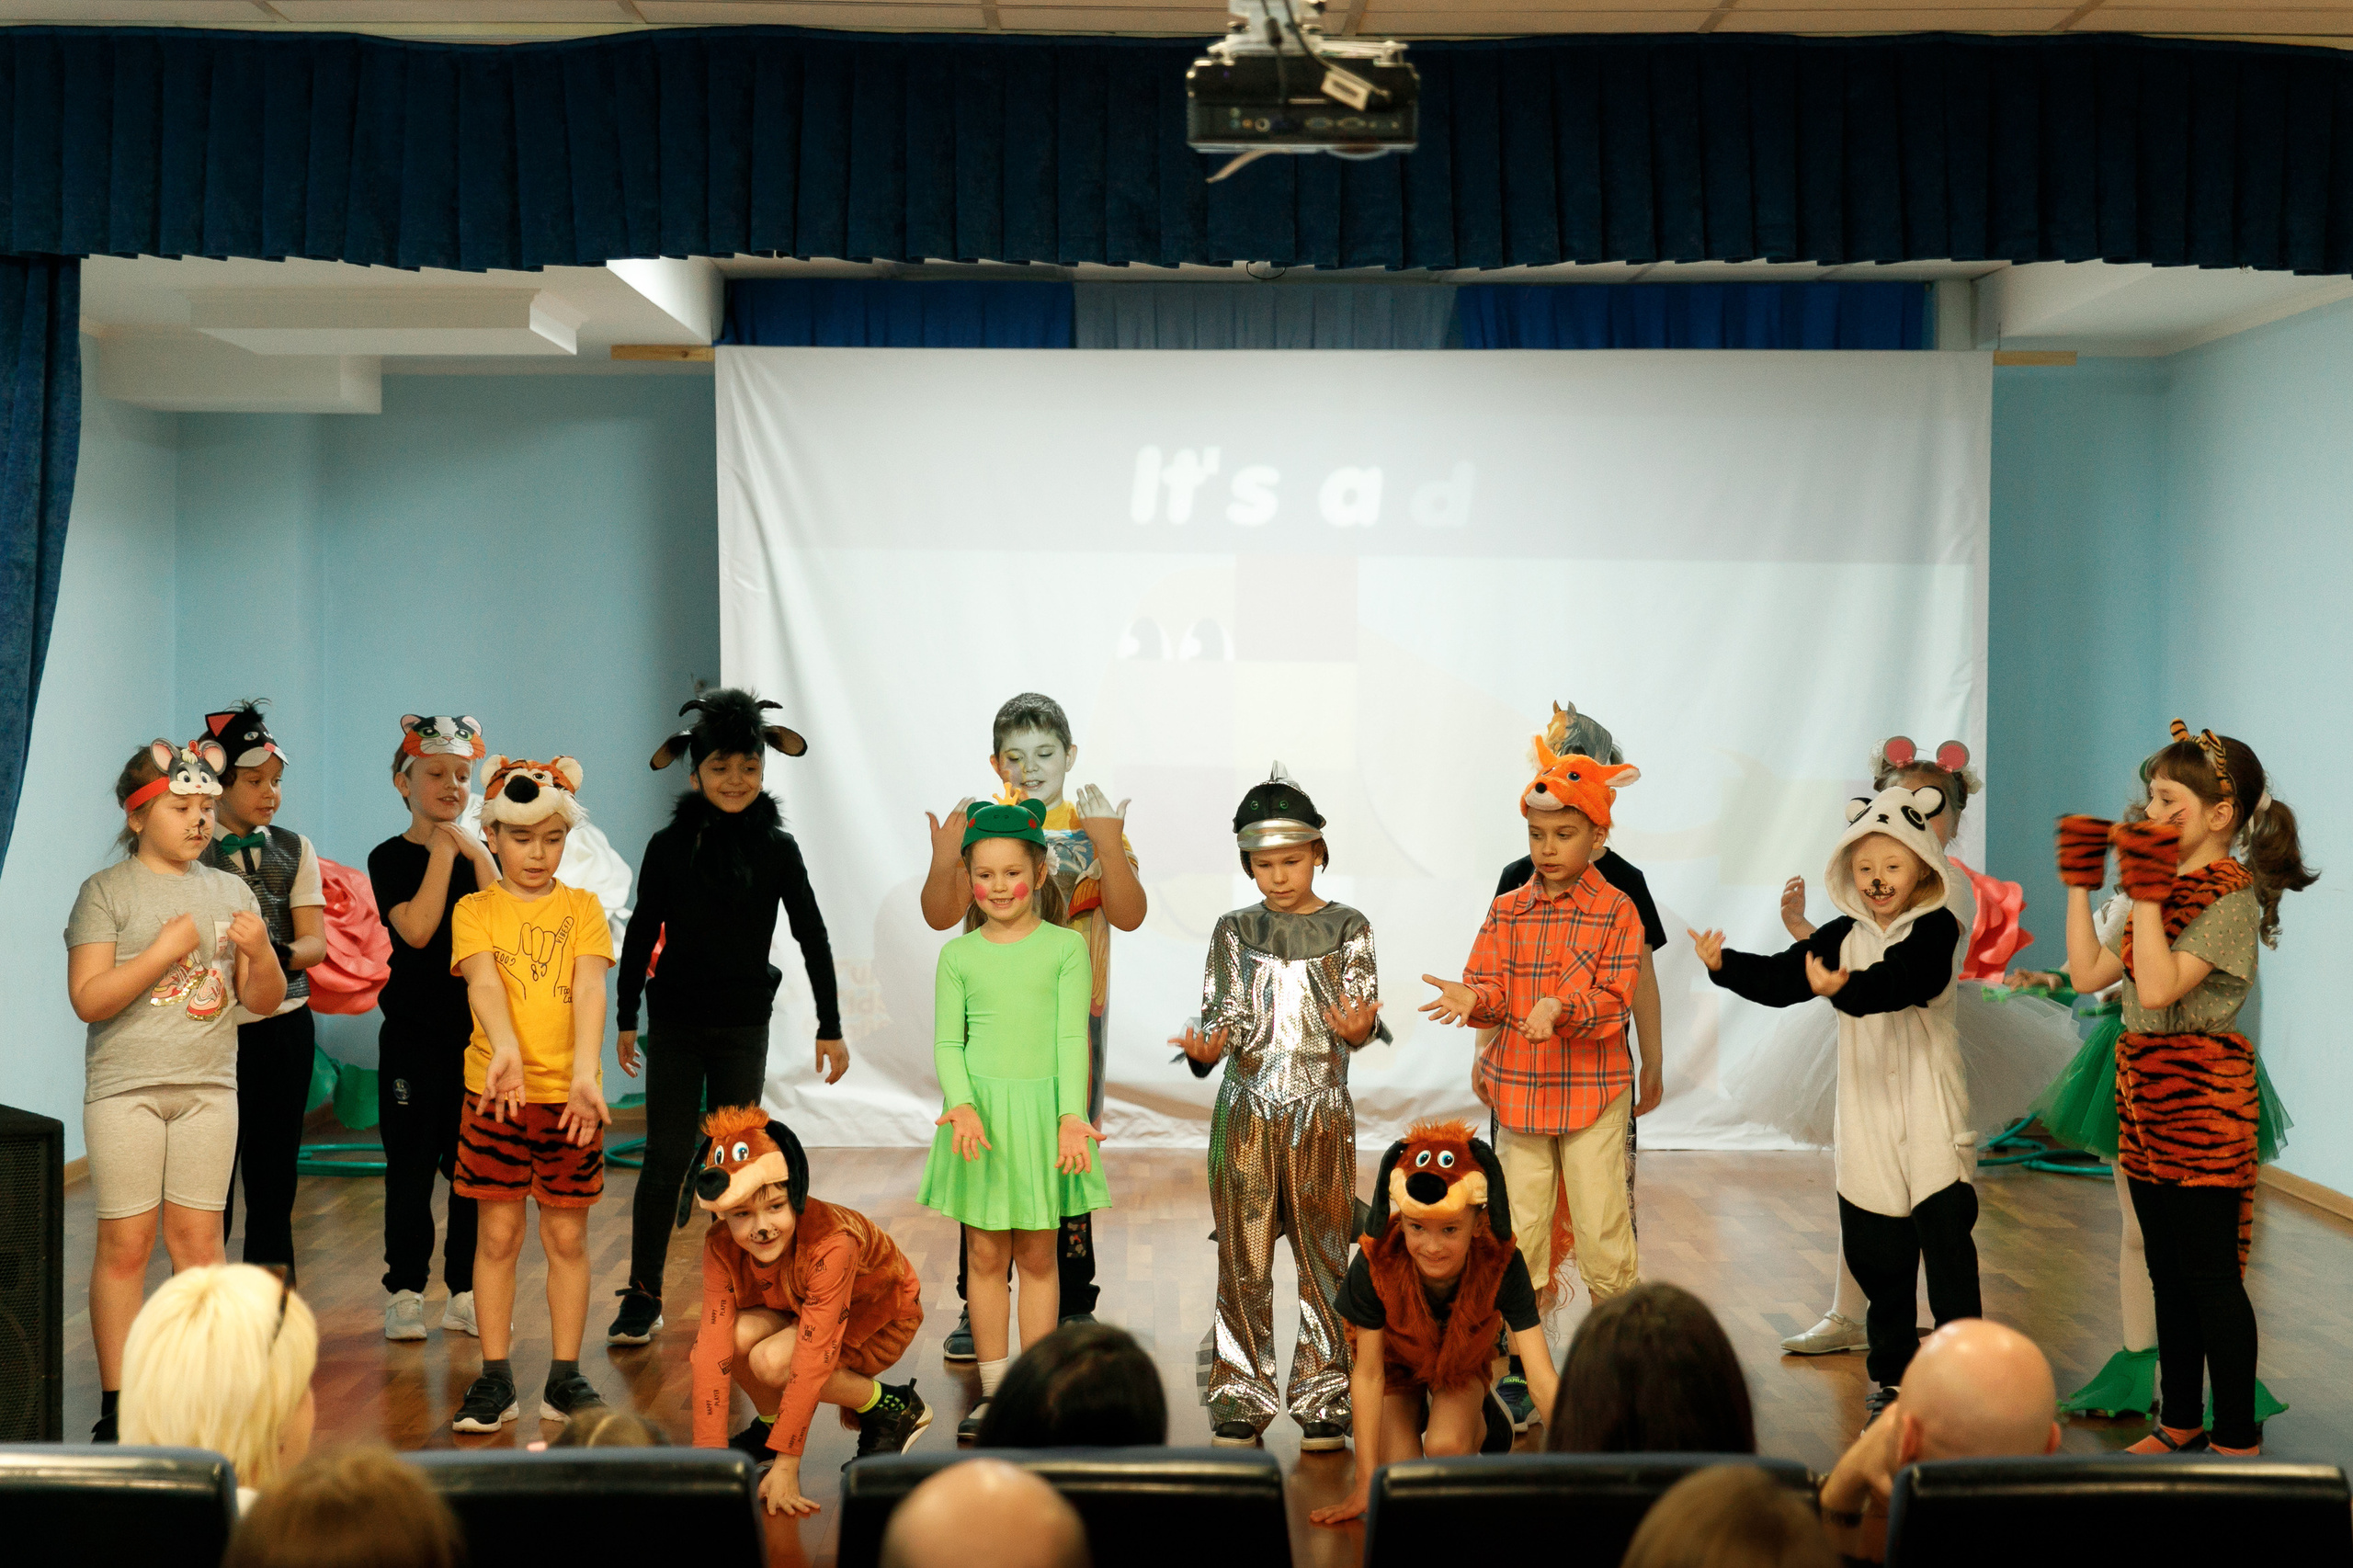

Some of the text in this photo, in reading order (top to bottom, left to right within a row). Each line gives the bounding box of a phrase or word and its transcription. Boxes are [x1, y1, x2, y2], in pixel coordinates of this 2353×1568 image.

[1131, 444, 1476, 528] It's a d
[557, 986, 571, 995] Too
